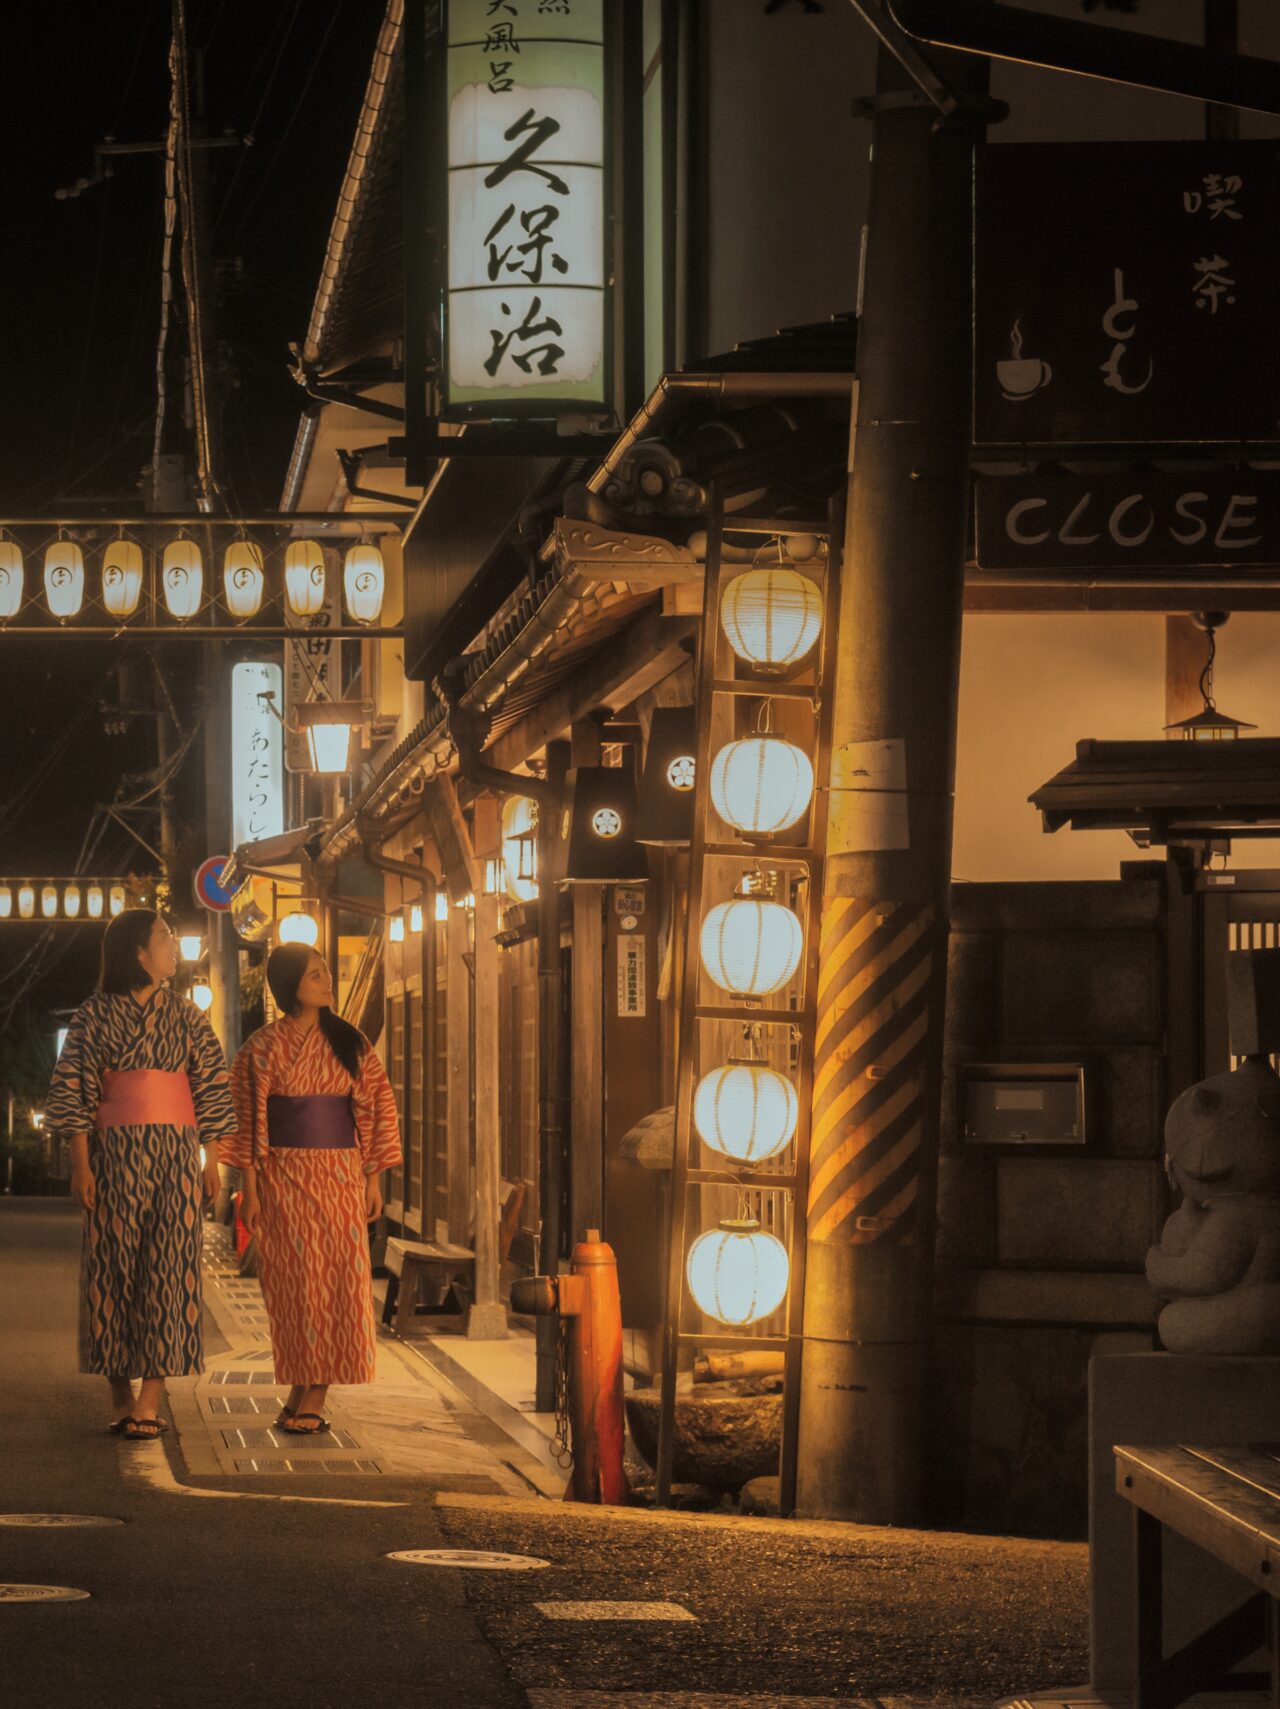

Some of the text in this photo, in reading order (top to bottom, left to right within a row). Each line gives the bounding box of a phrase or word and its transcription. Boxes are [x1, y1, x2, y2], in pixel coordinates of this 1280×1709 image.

[482, 107, 571, 378] 久保治
[1183, 173, 1244, 315] 喫茶
[1005, 491, 1265, 549] CLOSE
[247, 728, 270, 842] あたらし
